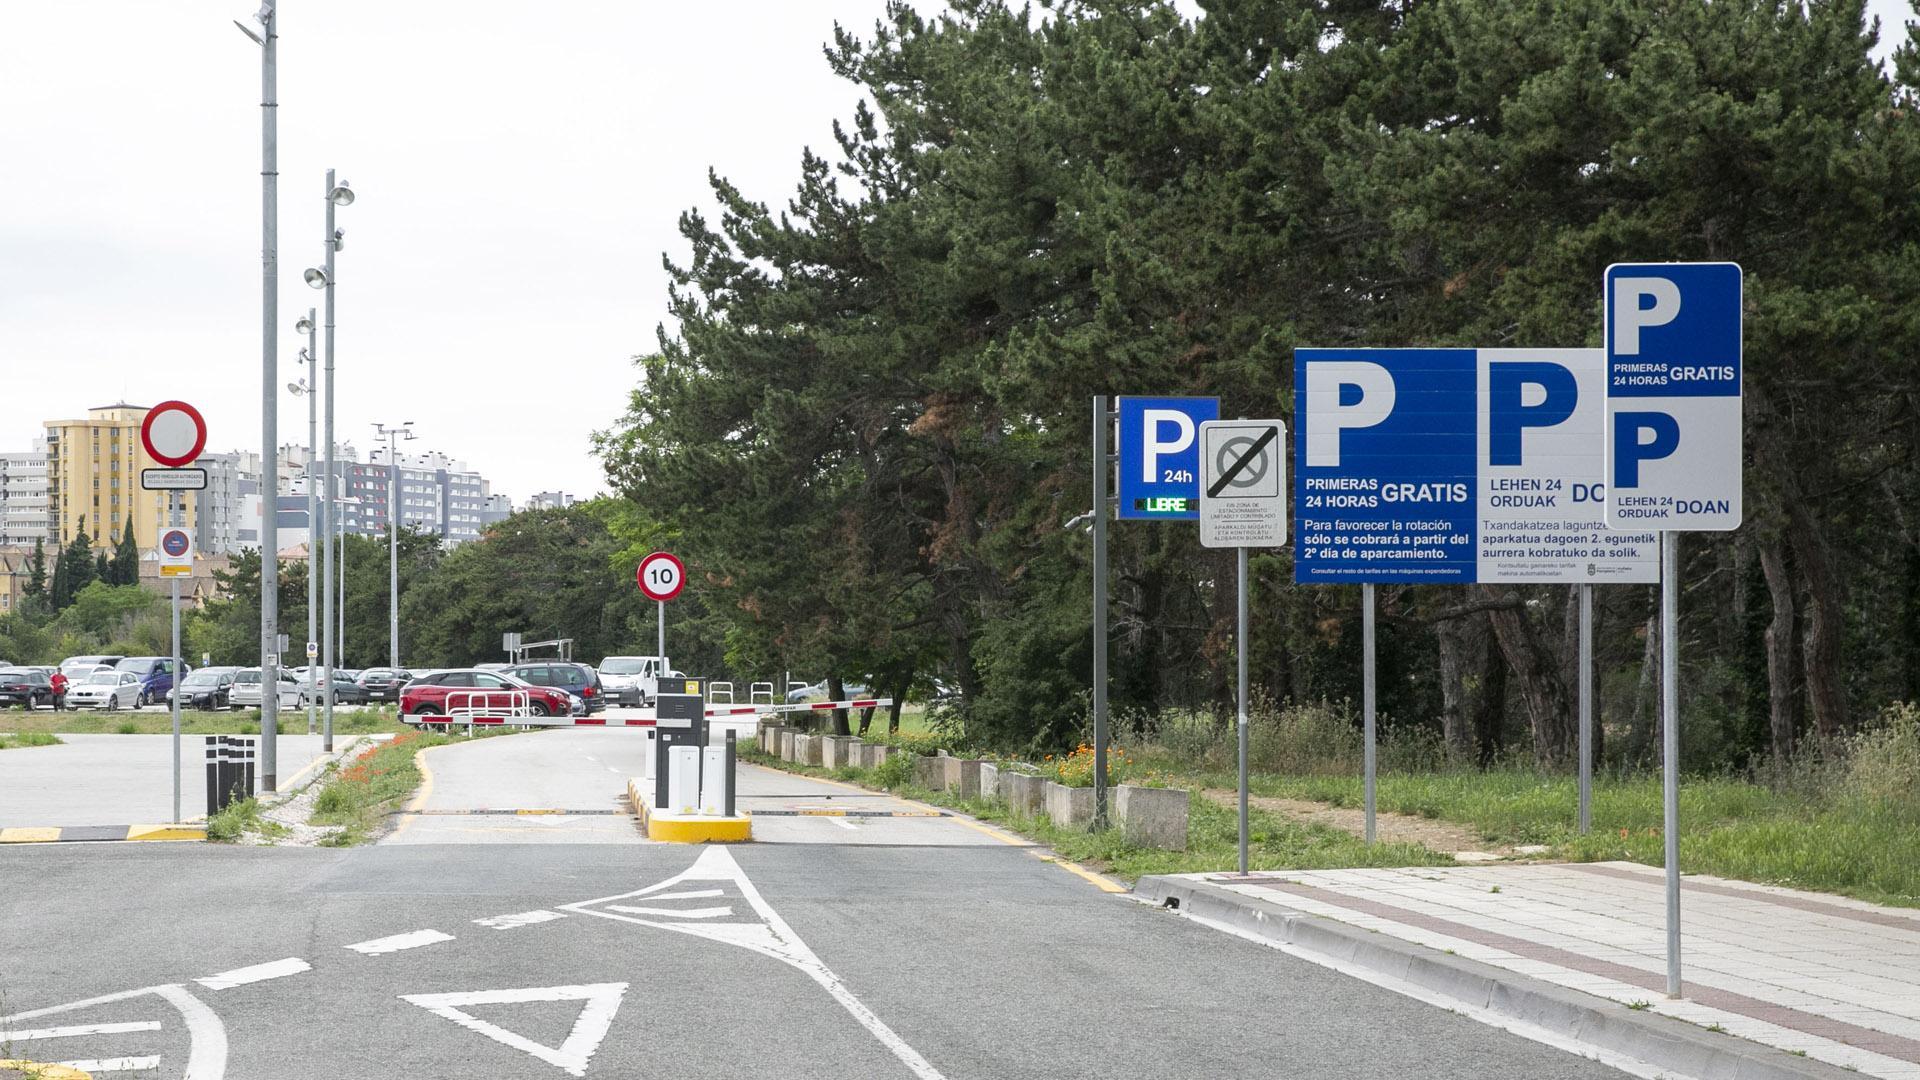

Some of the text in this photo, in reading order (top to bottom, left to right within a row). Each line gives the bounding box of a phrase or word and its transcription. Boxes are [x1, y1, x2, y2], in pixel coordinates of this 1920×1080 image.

[1614, 277, 1681, 355] P
[1613, 363, 1668, 373] PRIMERAS
[1670, 366, 1735, 381] GRATIS
[1613, 376, 1668, 386] 24 HORAS
[1306, 361, 1396, 467] P
[1489, 362, 1578, 466] P
[1143, 409, 1196, 483] P
[1614, 411, 1680, 488] P
[1164, 470, 1193, 483] 24h
[1305, 478, 1378, 490] PRIMERAS
[1490, 479, 1562, 491] LEHEN 24
[1381, 483, 1468, 503] GRATIS
[1146, 497, 1187, 512] LIBRE
[1305, 495, 1378, 508] 24 HORAS
[1490, 495, 1556, 507] ORDUAK
[1618, 497, 1673, 506] LEHEN 24
[1676, 500, 1730, 514] DOAN
[1618, 509, 1669, 518] ORDUAK
[1304, 519, 1452, 531] Para favorecer la rotación
[1483, 520, 1560, 531] Txandakatzea
[1304, 533, 1469, 547] sólo se cobrará a partir del
[1482, 533, 1656, 546] aparkatua dagoen 2. egunetik
[1320, 547, 1339, 559] día
[1341, 548, 1357, 559] de
[1360, 547, 1448, 561] aparcamiento.
[1482, 547, 1641, 558] aurrera kobratuko da solik.
[650, 568, 673, 585] 10
